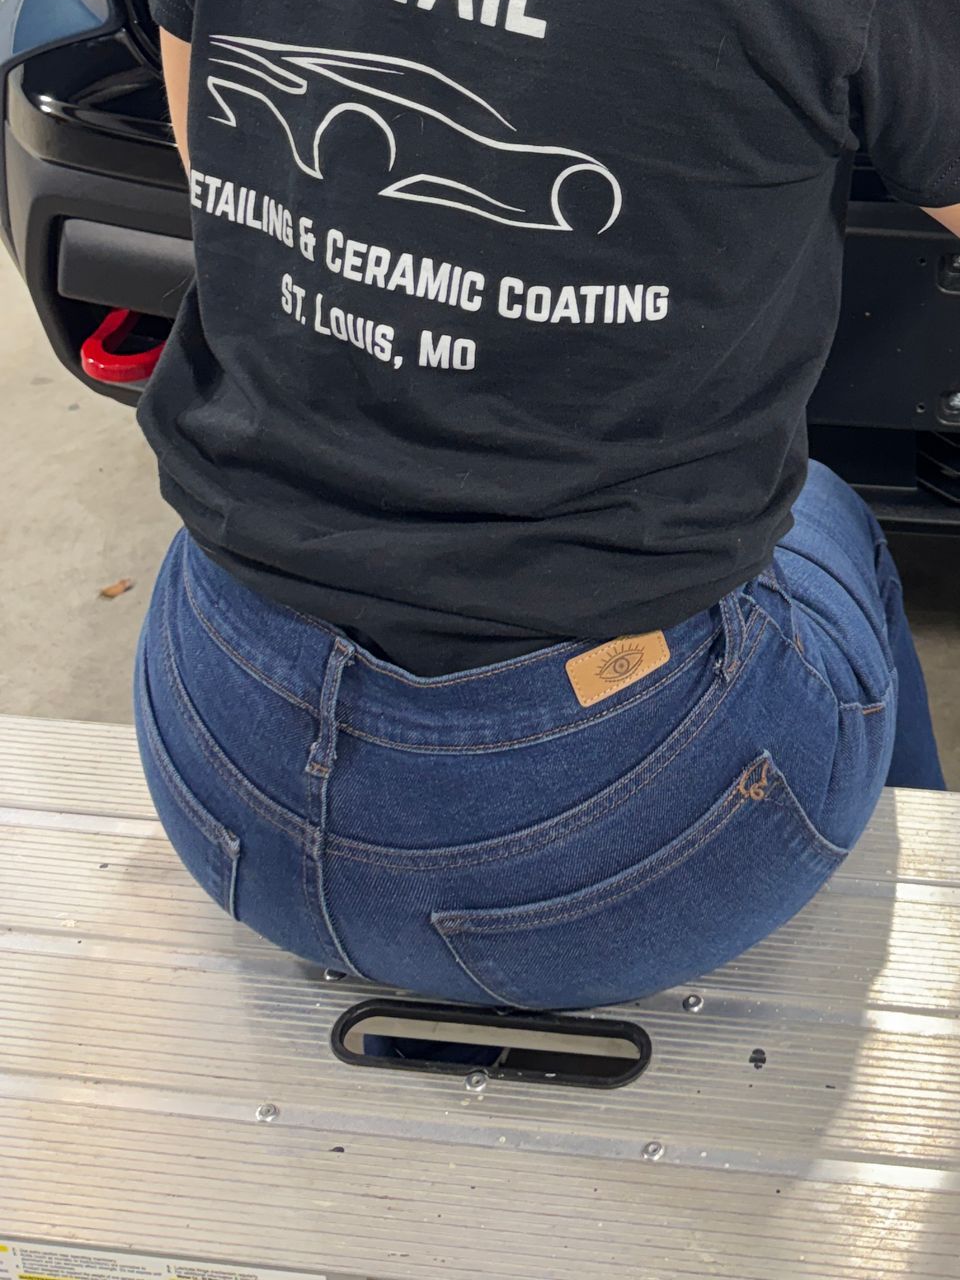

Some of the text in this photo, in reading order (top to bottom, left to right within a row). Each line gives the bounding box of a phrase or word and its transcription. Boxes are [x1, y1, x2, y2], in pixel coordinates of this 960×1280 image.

[191, 169, 670, 324] ETAILING & CERAMIC COATING
[281, 272, 477, 371] ST. LOUIS, MO
